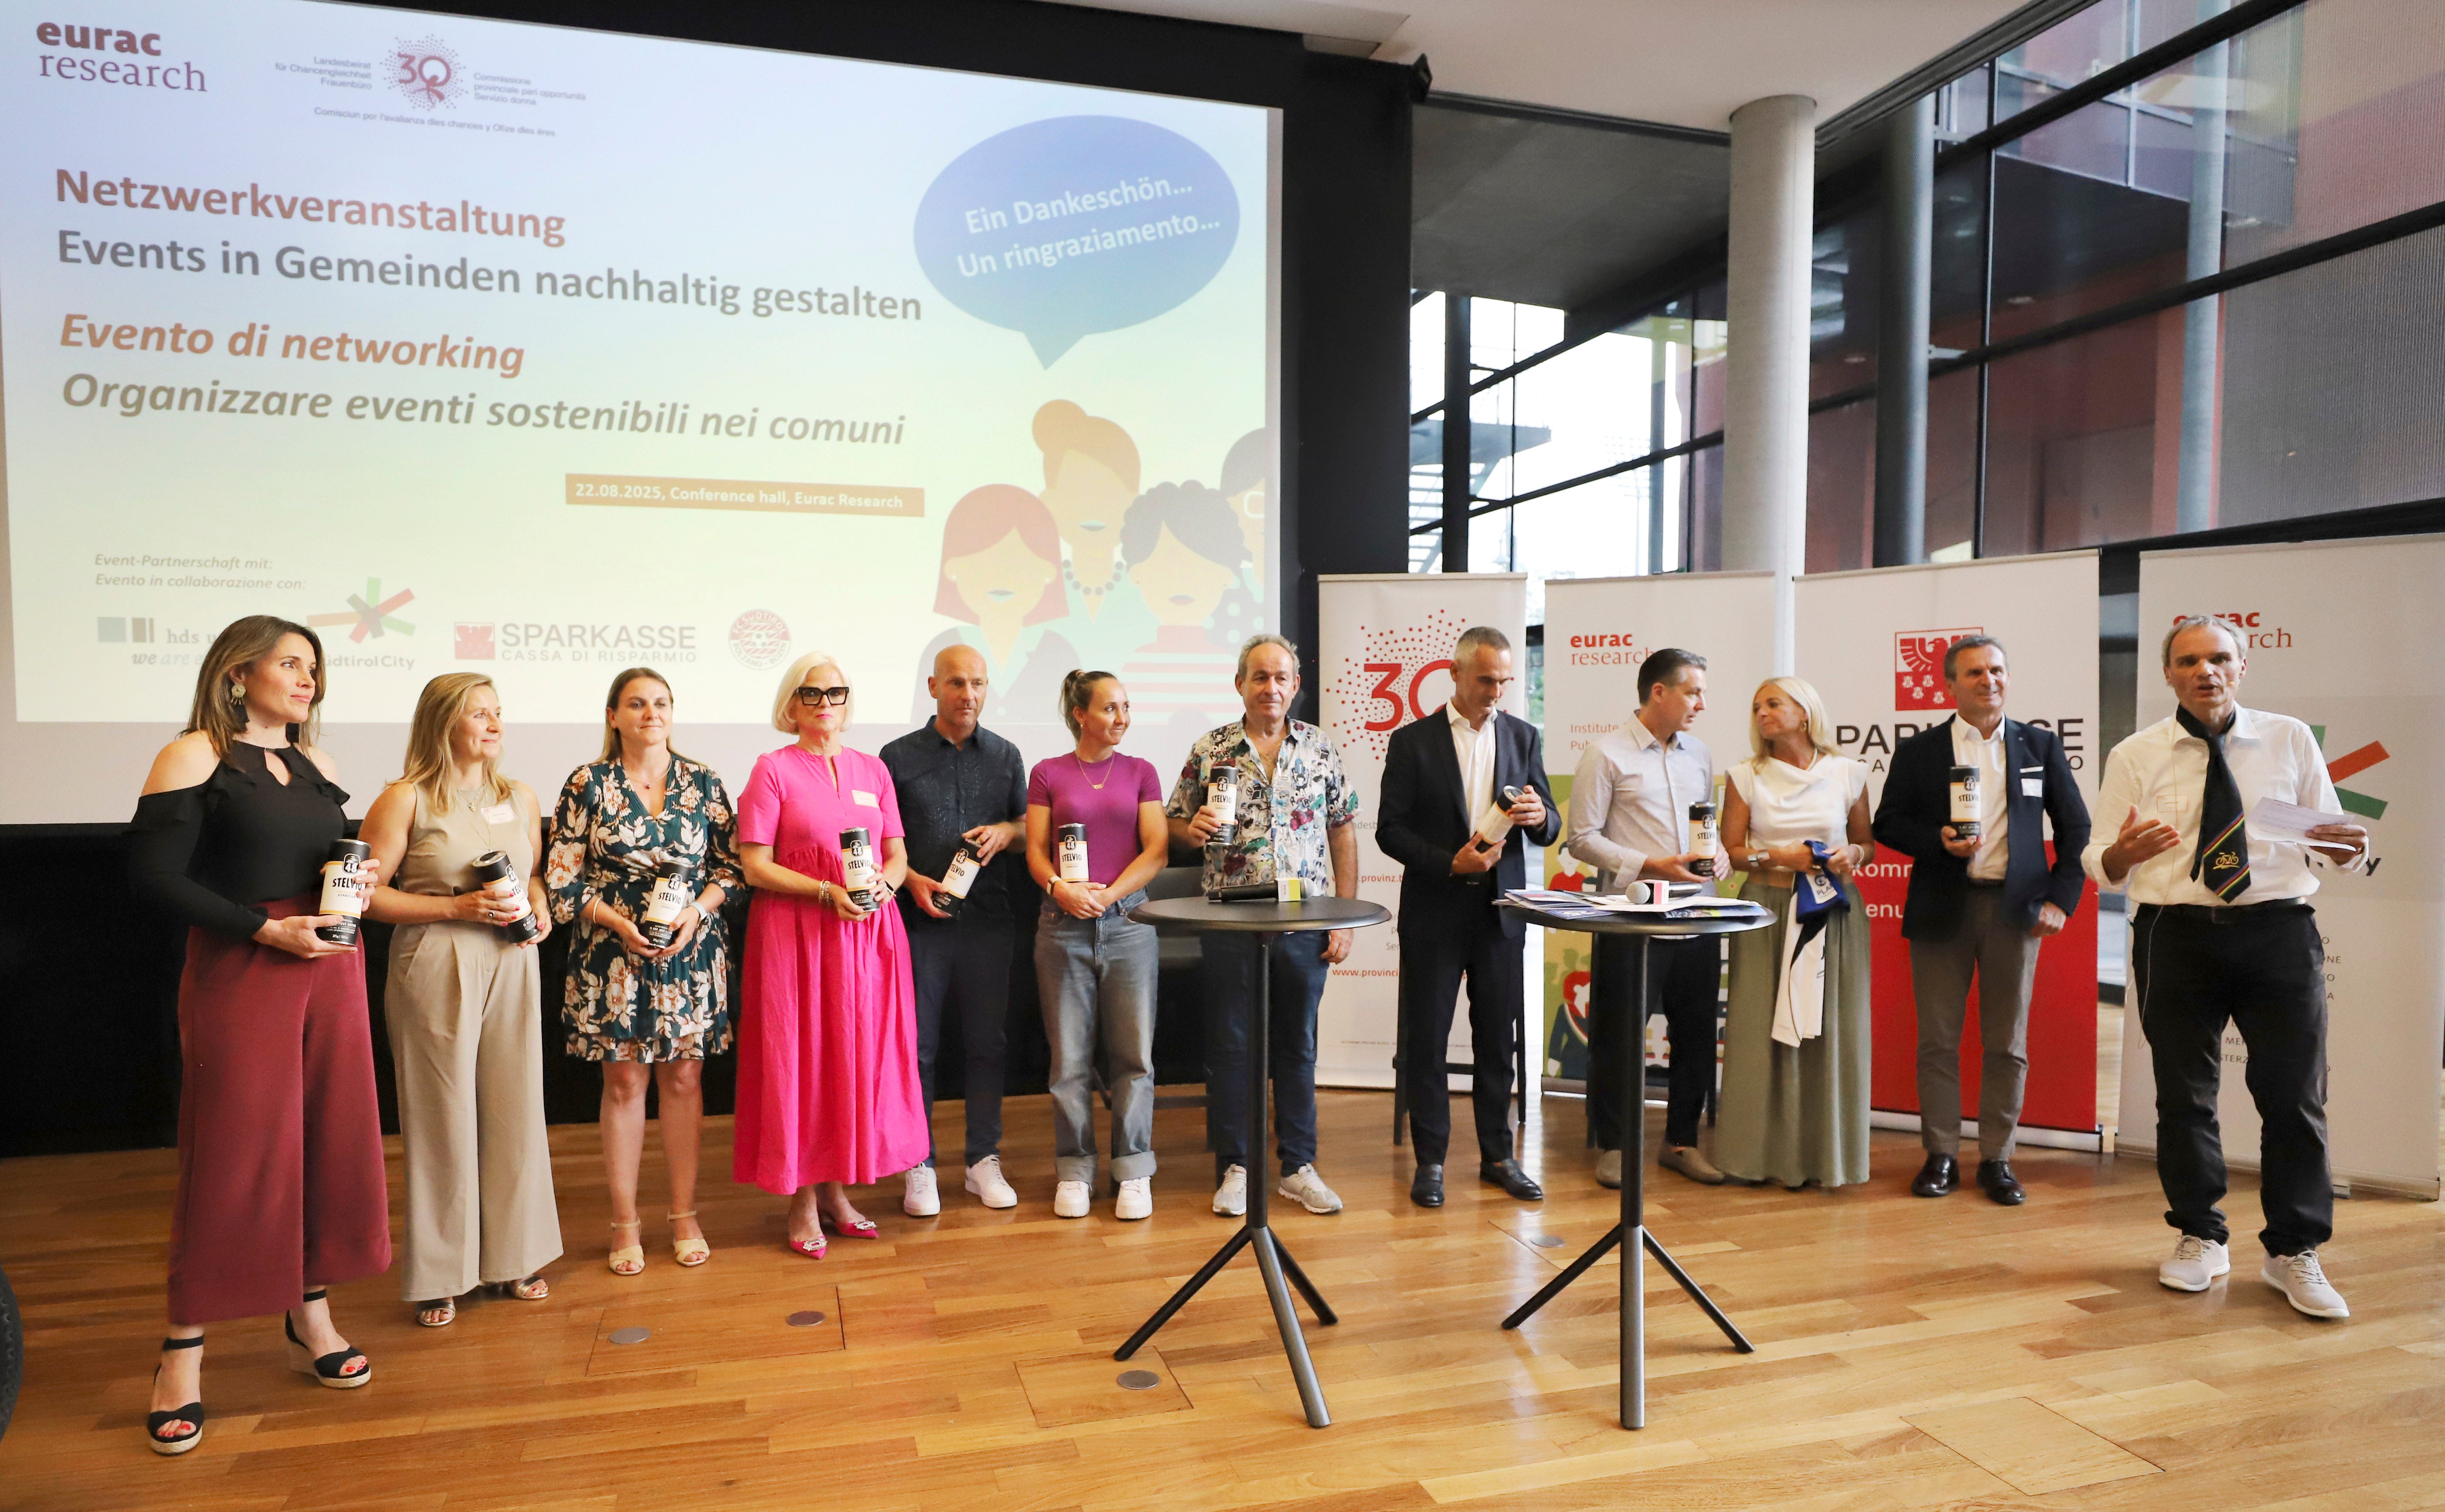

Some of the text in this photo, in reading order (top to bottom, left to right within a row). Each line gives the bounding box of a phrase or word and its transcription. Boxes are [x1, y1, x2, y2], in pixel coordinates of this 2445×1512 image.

[37, 21, 161, 56] eurac
[314, 56, 371, 69] Landesbeirat
[39, 52, 208, 91] research
[290, 64, 372, 79] Chancengleichheit
[474, 72, 531, 85] Commissione
[321, 78, 372, 89] Frauenbüro
[474, 84, 519, 94] provinciale
[474, 93, 536, 105] Servizio donna
[363, 113, 377, 121] por
[448, 120, 483, 130] chances
[57, 169, 565, 247] Netzwerkveranstaltung
[965, 177, 1192, 233] Ein Dankeschön...
[957, 214, 1220, 277] Un ringraziamento...
[59, 230, 921, 320] Events in Gemeinden nachhaltig gestalten
[61, 314, 524, 378] Evento di networking
[63, 373, 906, 444] Organizzare eventi sostenibili nei comuni
[576, 483, 903, 508] 22.08.2025, Conference hall, Eurac Research
[95, 554, 272, 570] Event-Partnerschaft mit:
[96, 574, 307, 590] Evento in collaborazione con:
[167, 629, 199, 643] hds
[501, 623, 696, 649] SPARKASSE
[1571, 634, 1633, 647] eurac
[132, 654, 156, 664] we
[161, 654, 189, 664] are
[502, 649, 696, 663] CASSA DI RISPARMIO
[1212, 794, 1232, 803] STELVIO
[853, 847, 862, 856] 48
[345, 863, 358, 873] 48
[848, 859, 870, 869] STELVIO
[669, 881, 680, 889] 48
[658, 892, 681, 904] STELVIO
[1332, 968, 1399, 978] www.provinci
